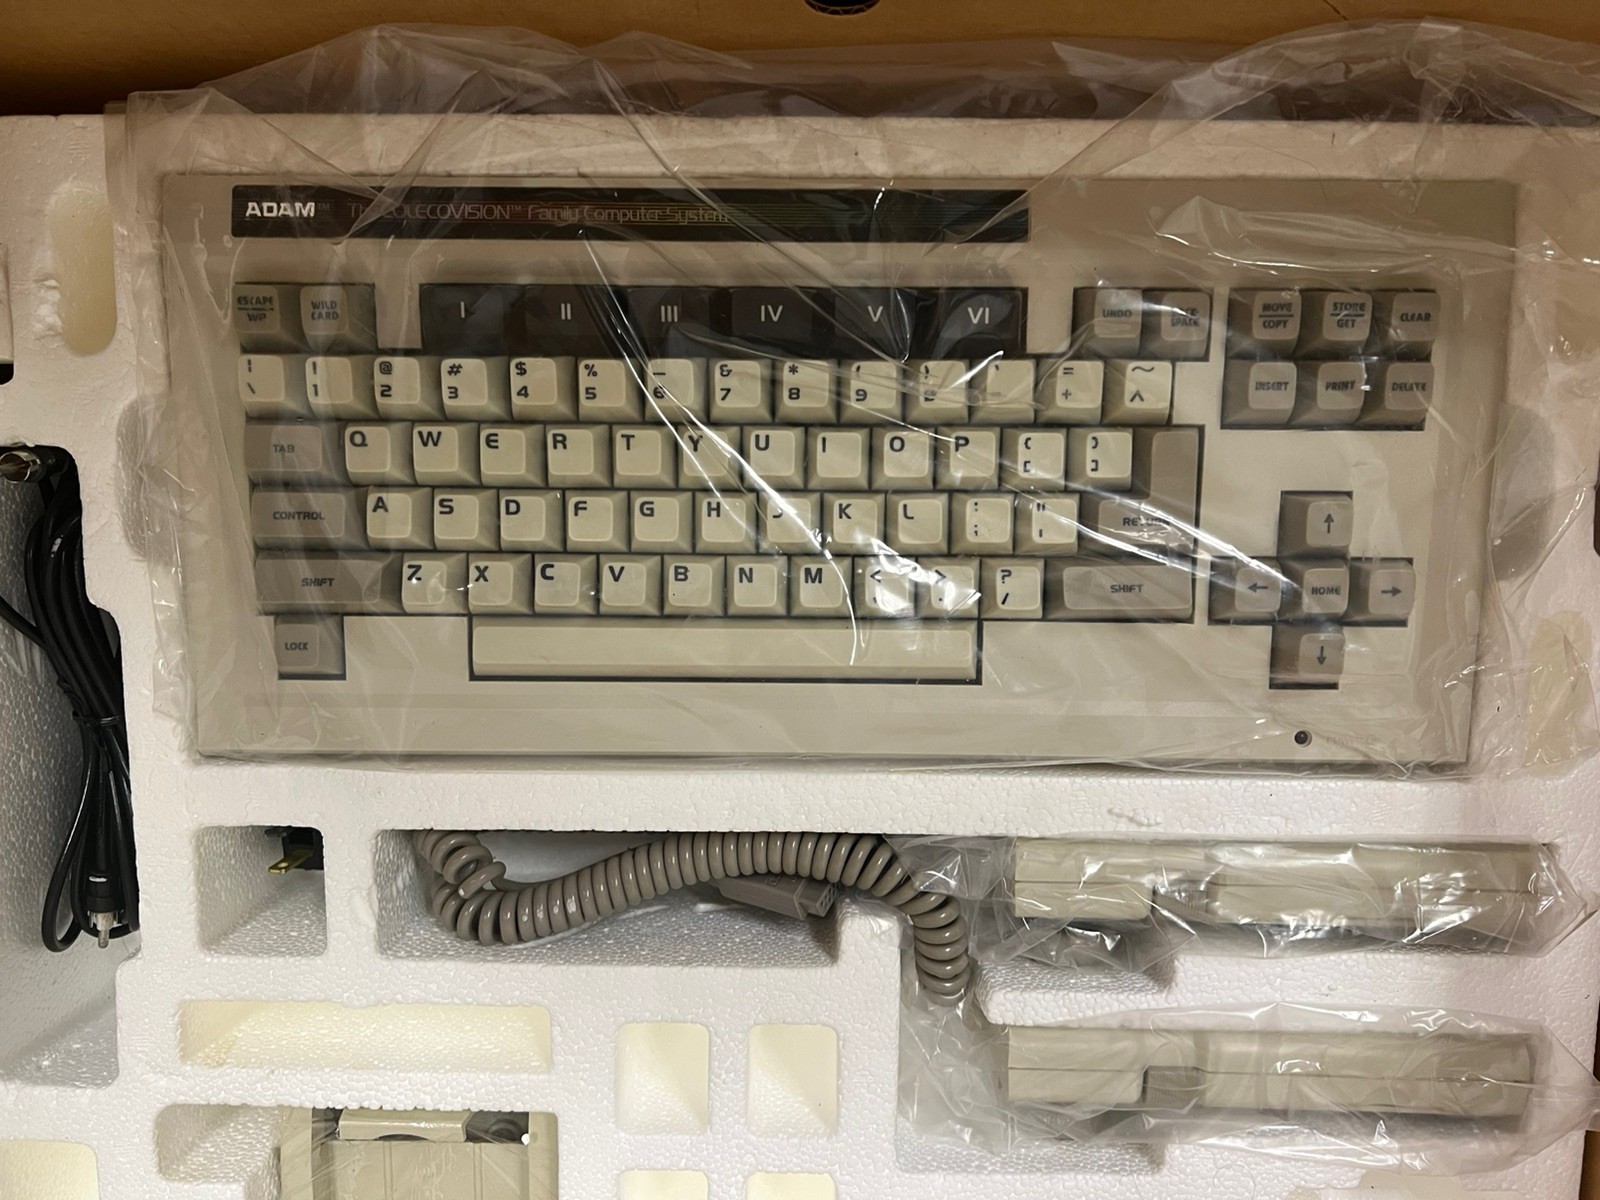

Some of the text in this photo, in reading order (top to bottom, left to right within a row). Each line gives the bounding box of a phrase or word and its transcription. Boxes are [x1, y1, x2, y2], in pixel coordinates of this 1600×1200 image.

[237, 296, 274, 305] ESCAPE
[311, 301, 337, 310] WILD
[1332, 302, 1366, 311] STORE
[560, 303, 572, 320] II
[660, 306, 679, 322] III
[760, 305, 784, 322] IV
[868, 306, 884, 322] V
[1102, 309, 1133, 318] UNDO
[1262, 303, 1293, 312] MOVE
[247, 312, 267, 321] WP
[311, 311, 339, 320] CARD
[967, 307, 990, 324] VI
[1400, 313, 1431, 322] CLEAR
[1262, 319, 1289, 329] COPY
[1336, 319, 1357, 328] GET
[379, 361, 393, 375] @
[447, 363, 463, 376] #
[515, 361, 527, 376] $
[584, 364, 598, 377] %
[720, 364, 732, 377] &
[313, 384, 318, 396] 1
[380, 385, 392, 397] 2
[516, 386, 529, 398] 4
[1255, 382, 1289, 390] INSERT
[1325, 381, 1355, 391] PRINT
[1391, 382, 1426, 391] DELETE
[447, 387, 459, 399] 3
[585, 387, 597, 400] 5
[653, 387, 665, 399] 6
[720, 388, 731, 401] 7
[788, 388, 800, 400] 8
[855, 389, 867, 401] 9
[1062, 389, 1071, 400] +
[349, 430, 368, 447] Q
[418, 431, 442, 447] W
[485, 433, 499, 449] E
[552, 433, 567, 450] R
[621, 434, 635, 450] T
[688, 435, 703, 451] Y
[755, 434, 769, 451] U
[889, 436, 905, 452] O
[955, 436, 969, 452] P
[273, 444, 295, 453] TAB
[372, 496, 389, 513] A
[439, 498, 454, 515] S
[505, 499, 521, 515] D
[574, 501, 588, 517] F
[639, 501, 655, 517] G
[707, 501, 721, 518] H
[273, 511, 325, 521] CONTROL
[838, 503, 852, 520] K
[903, 504, 914, 520] L
[407, 564, 422, 581] Z
[474, 565, 489, 582] X
[540, 564, 554, 581] C
[608, 565, 625, 582] V
[674, 565, 689, 582] B
[739, 567, 753, 583] N
[804, 567, 823, 584] M
[1001, 569, 1012, 584] ?
[301, 577, 335, 587] SHIFT
[1110, 584, 1143, 593] SHIFT
[1311, 586, 1341, 595] HOME
[285, 641, 309, 651] LOCK
